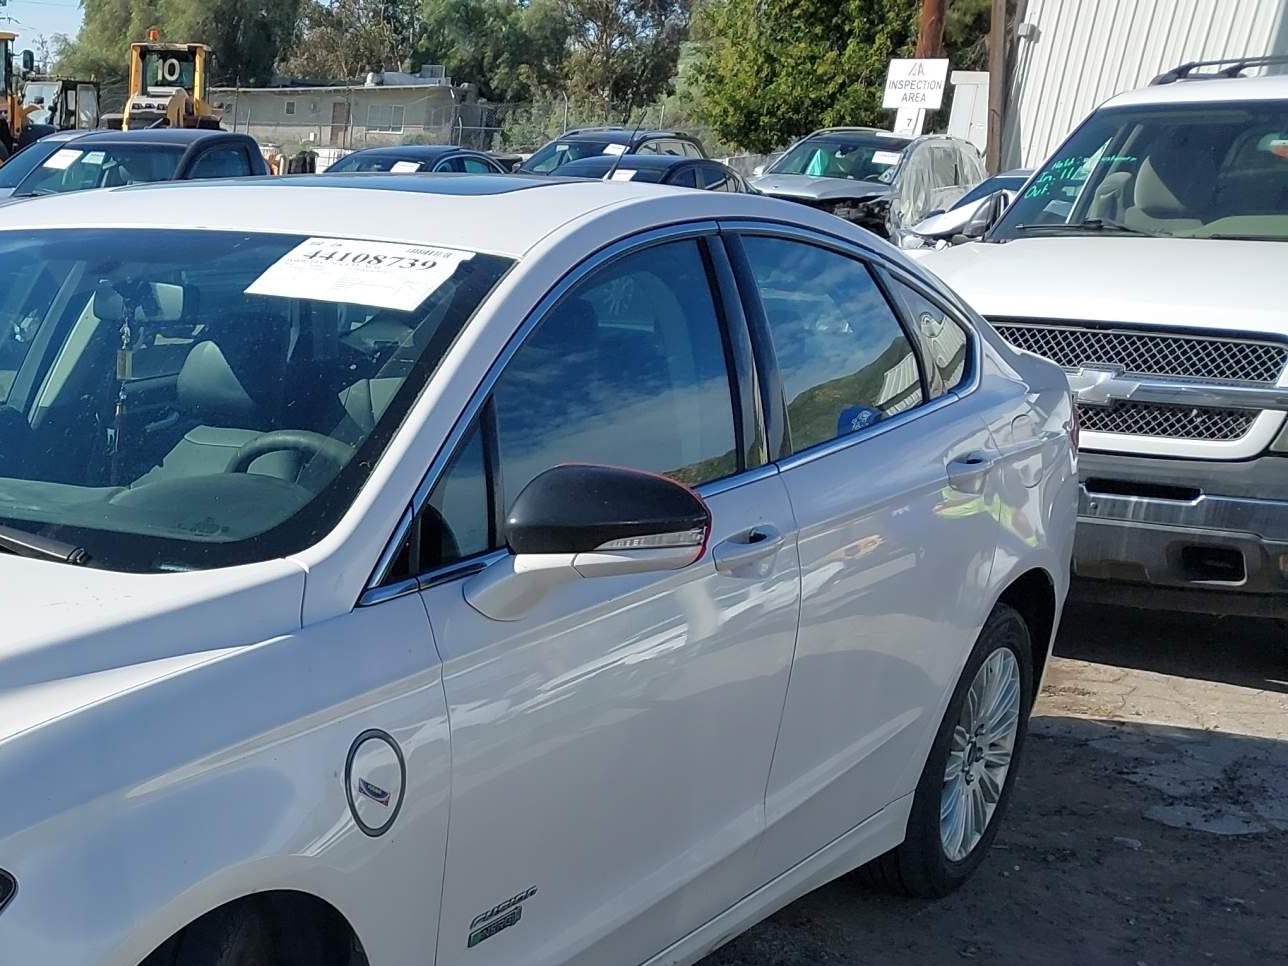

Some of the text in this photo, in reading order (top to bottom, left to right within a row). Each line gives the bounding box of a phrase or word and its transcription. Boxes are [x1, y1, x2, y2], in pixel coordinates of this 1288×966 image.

[153, 58, 180, 81] 10
[888, 79, 943, 90] INSPECTION
[901, 92, 926, 103] AREA
[907, 118, 913, 128] 7
[303, 249, 438, 271] 44108739
